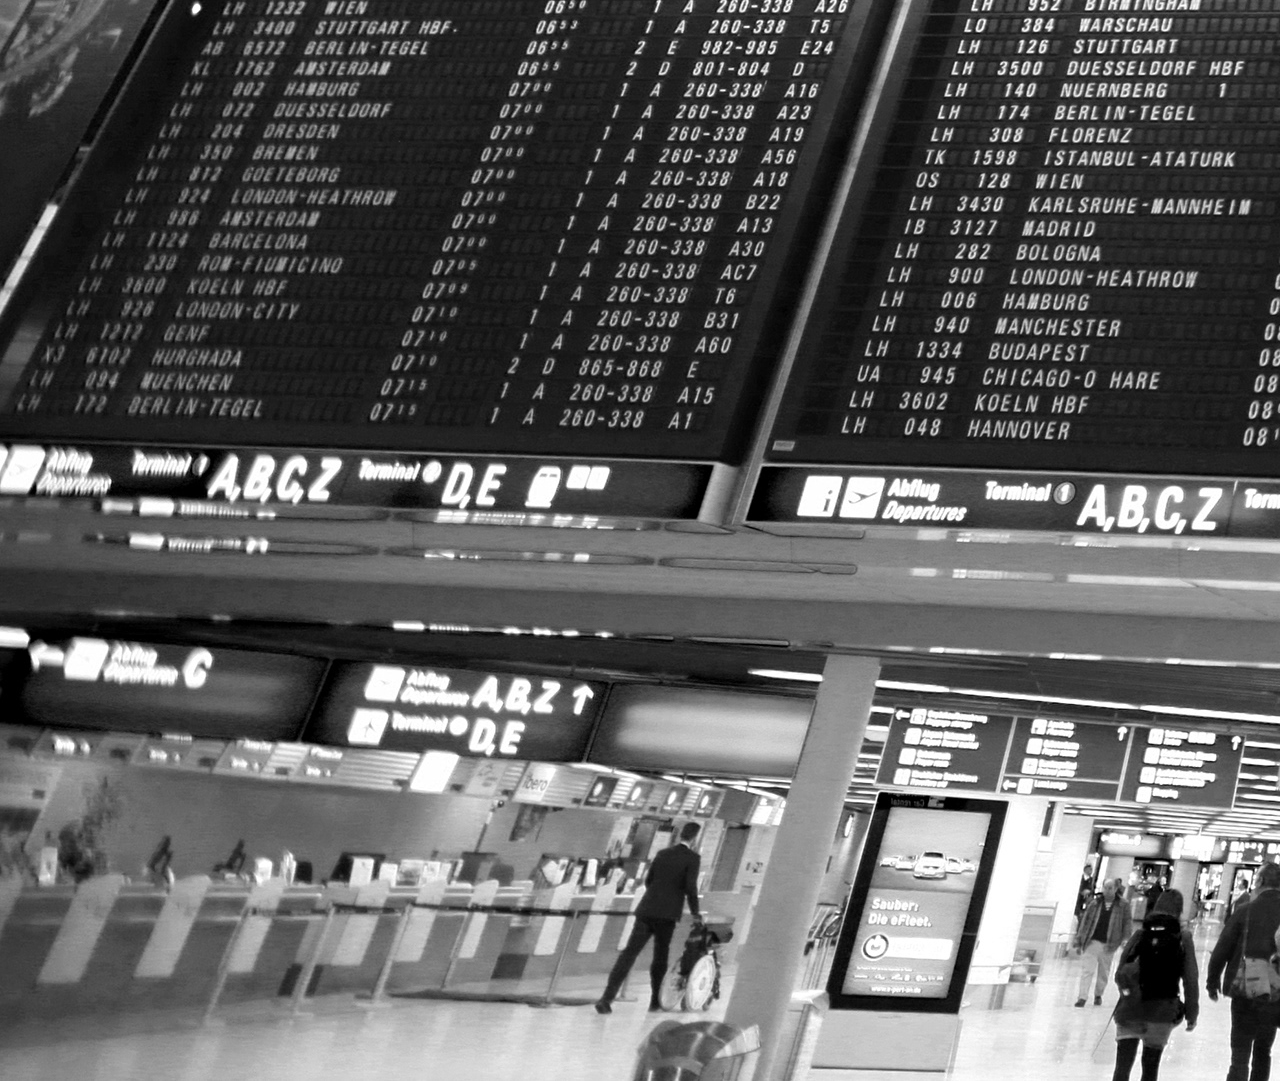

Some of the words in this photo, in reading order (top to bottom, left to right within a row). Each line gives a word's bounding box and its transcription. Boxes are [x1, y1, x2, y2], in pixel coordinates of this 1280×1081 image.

[315, 21, 410, 35] STUTTGART
[701, 40, 778, 55] 982-985
[800, 41, 833, 55] E24
[294, 61, 391, 75] AMSTERDAM
[1067, 61, 1196, 76] DUESSELDORF
[1209, 61, 1244, 76] HBF
[274, 103, 392, 118] DUESSELDORF
[1044, 150, 1235, 167] ISTANBUL-ATATURK
[1028, 197, 1251, 215] KARLSRUHE-MANNHEIM
[1022, 220, 1095, 237] MADRID
[209, 233, 307, 249] BARCELONA
[198, 255, 343, 273] ROM-FIUMICINO
[995, 318, 1121, 337] MANCHESTER
[152, 349, 242, 367] HURGHADA
[920, 366, 956, 384] 945
[1109, 372, 1160, 390] HARE
[967, 420, 1070, 440] HANNOVER
[207, 452, 343, 505] A,B,C,Z
[359, 458, 421, 481] Terminal
[441, 462, 507, 509] D,E
[881, 501, 967, 523] Departures
[887, 478, 940, 501] Abflug
[984, 481, 1052, 503] Terminal
[1076, 483, 1224, 534] A,B,C,Z
[183, 647, 213, 689] C
[472, 675, 561, 715] A,B,Z
[468, 718, 525, 756] D,E
[867, 913, 888, 925] Die
